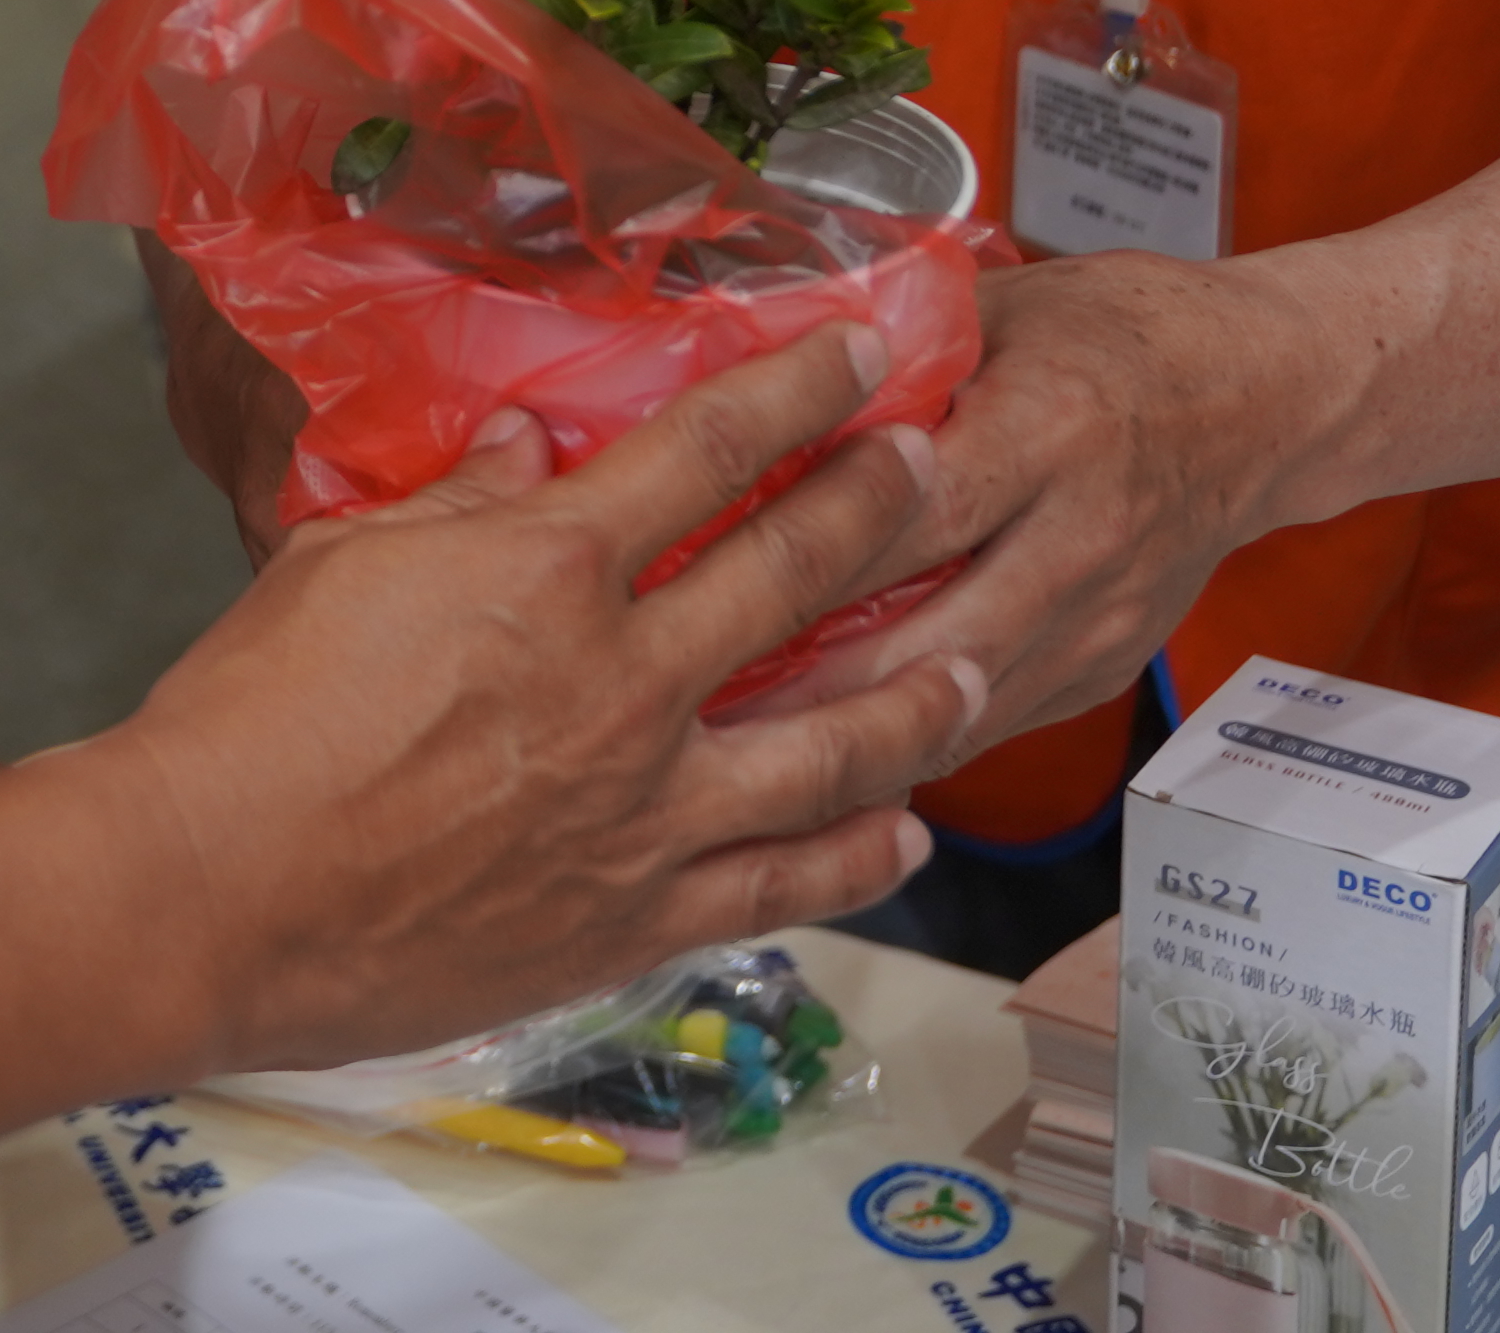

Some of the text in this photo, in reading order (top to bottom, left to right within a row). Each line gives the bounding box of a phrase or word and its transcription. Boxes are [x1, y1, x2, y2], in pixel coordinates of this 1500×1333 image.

[1257, 677, 1344, 706] DECO
[1160, 863, 1259, 916] GS27
[1337, 868, 1432, 912] DECO
[1153, 936, 1417, 1038] 韓風高硼矽玻璃水瓶
[1152, 996, 1331, 1094] Glass
[1193, 1096, 1414, 1200] Bottle
